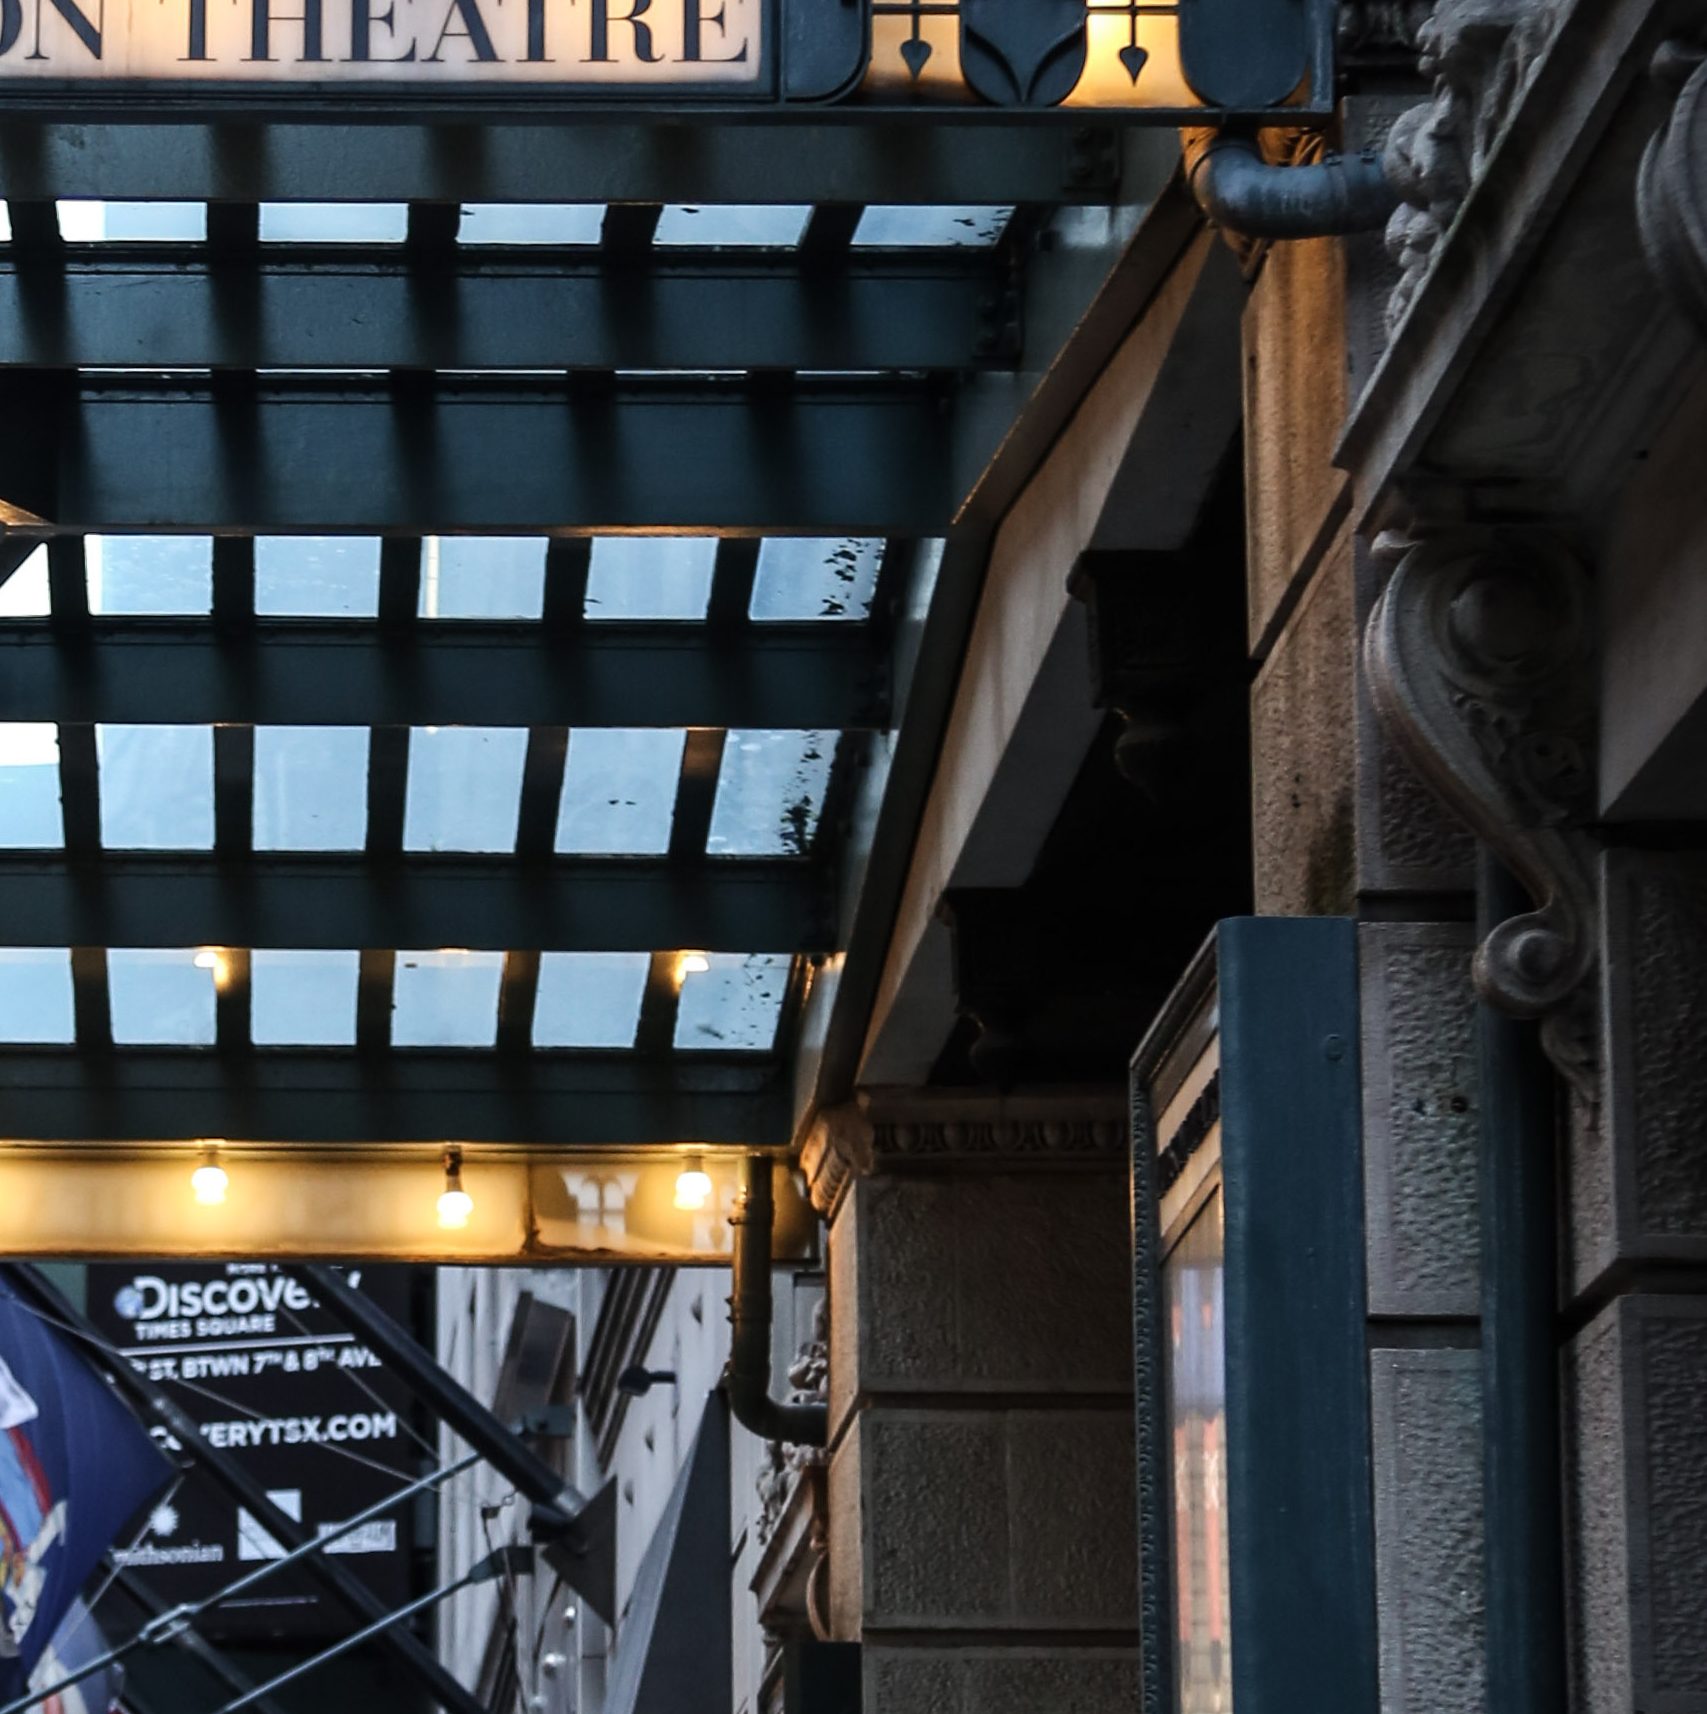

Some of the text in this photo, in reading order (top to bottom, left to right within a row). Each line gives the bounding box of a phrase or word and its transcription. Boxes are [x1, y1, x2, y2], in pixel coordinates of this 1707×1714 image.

[133, 1273, 361, 1321] DISCOVE
[134, 1313, 276, 1340] TIMES SQUARE
[181, 1356, 250, 1380] BTWN
